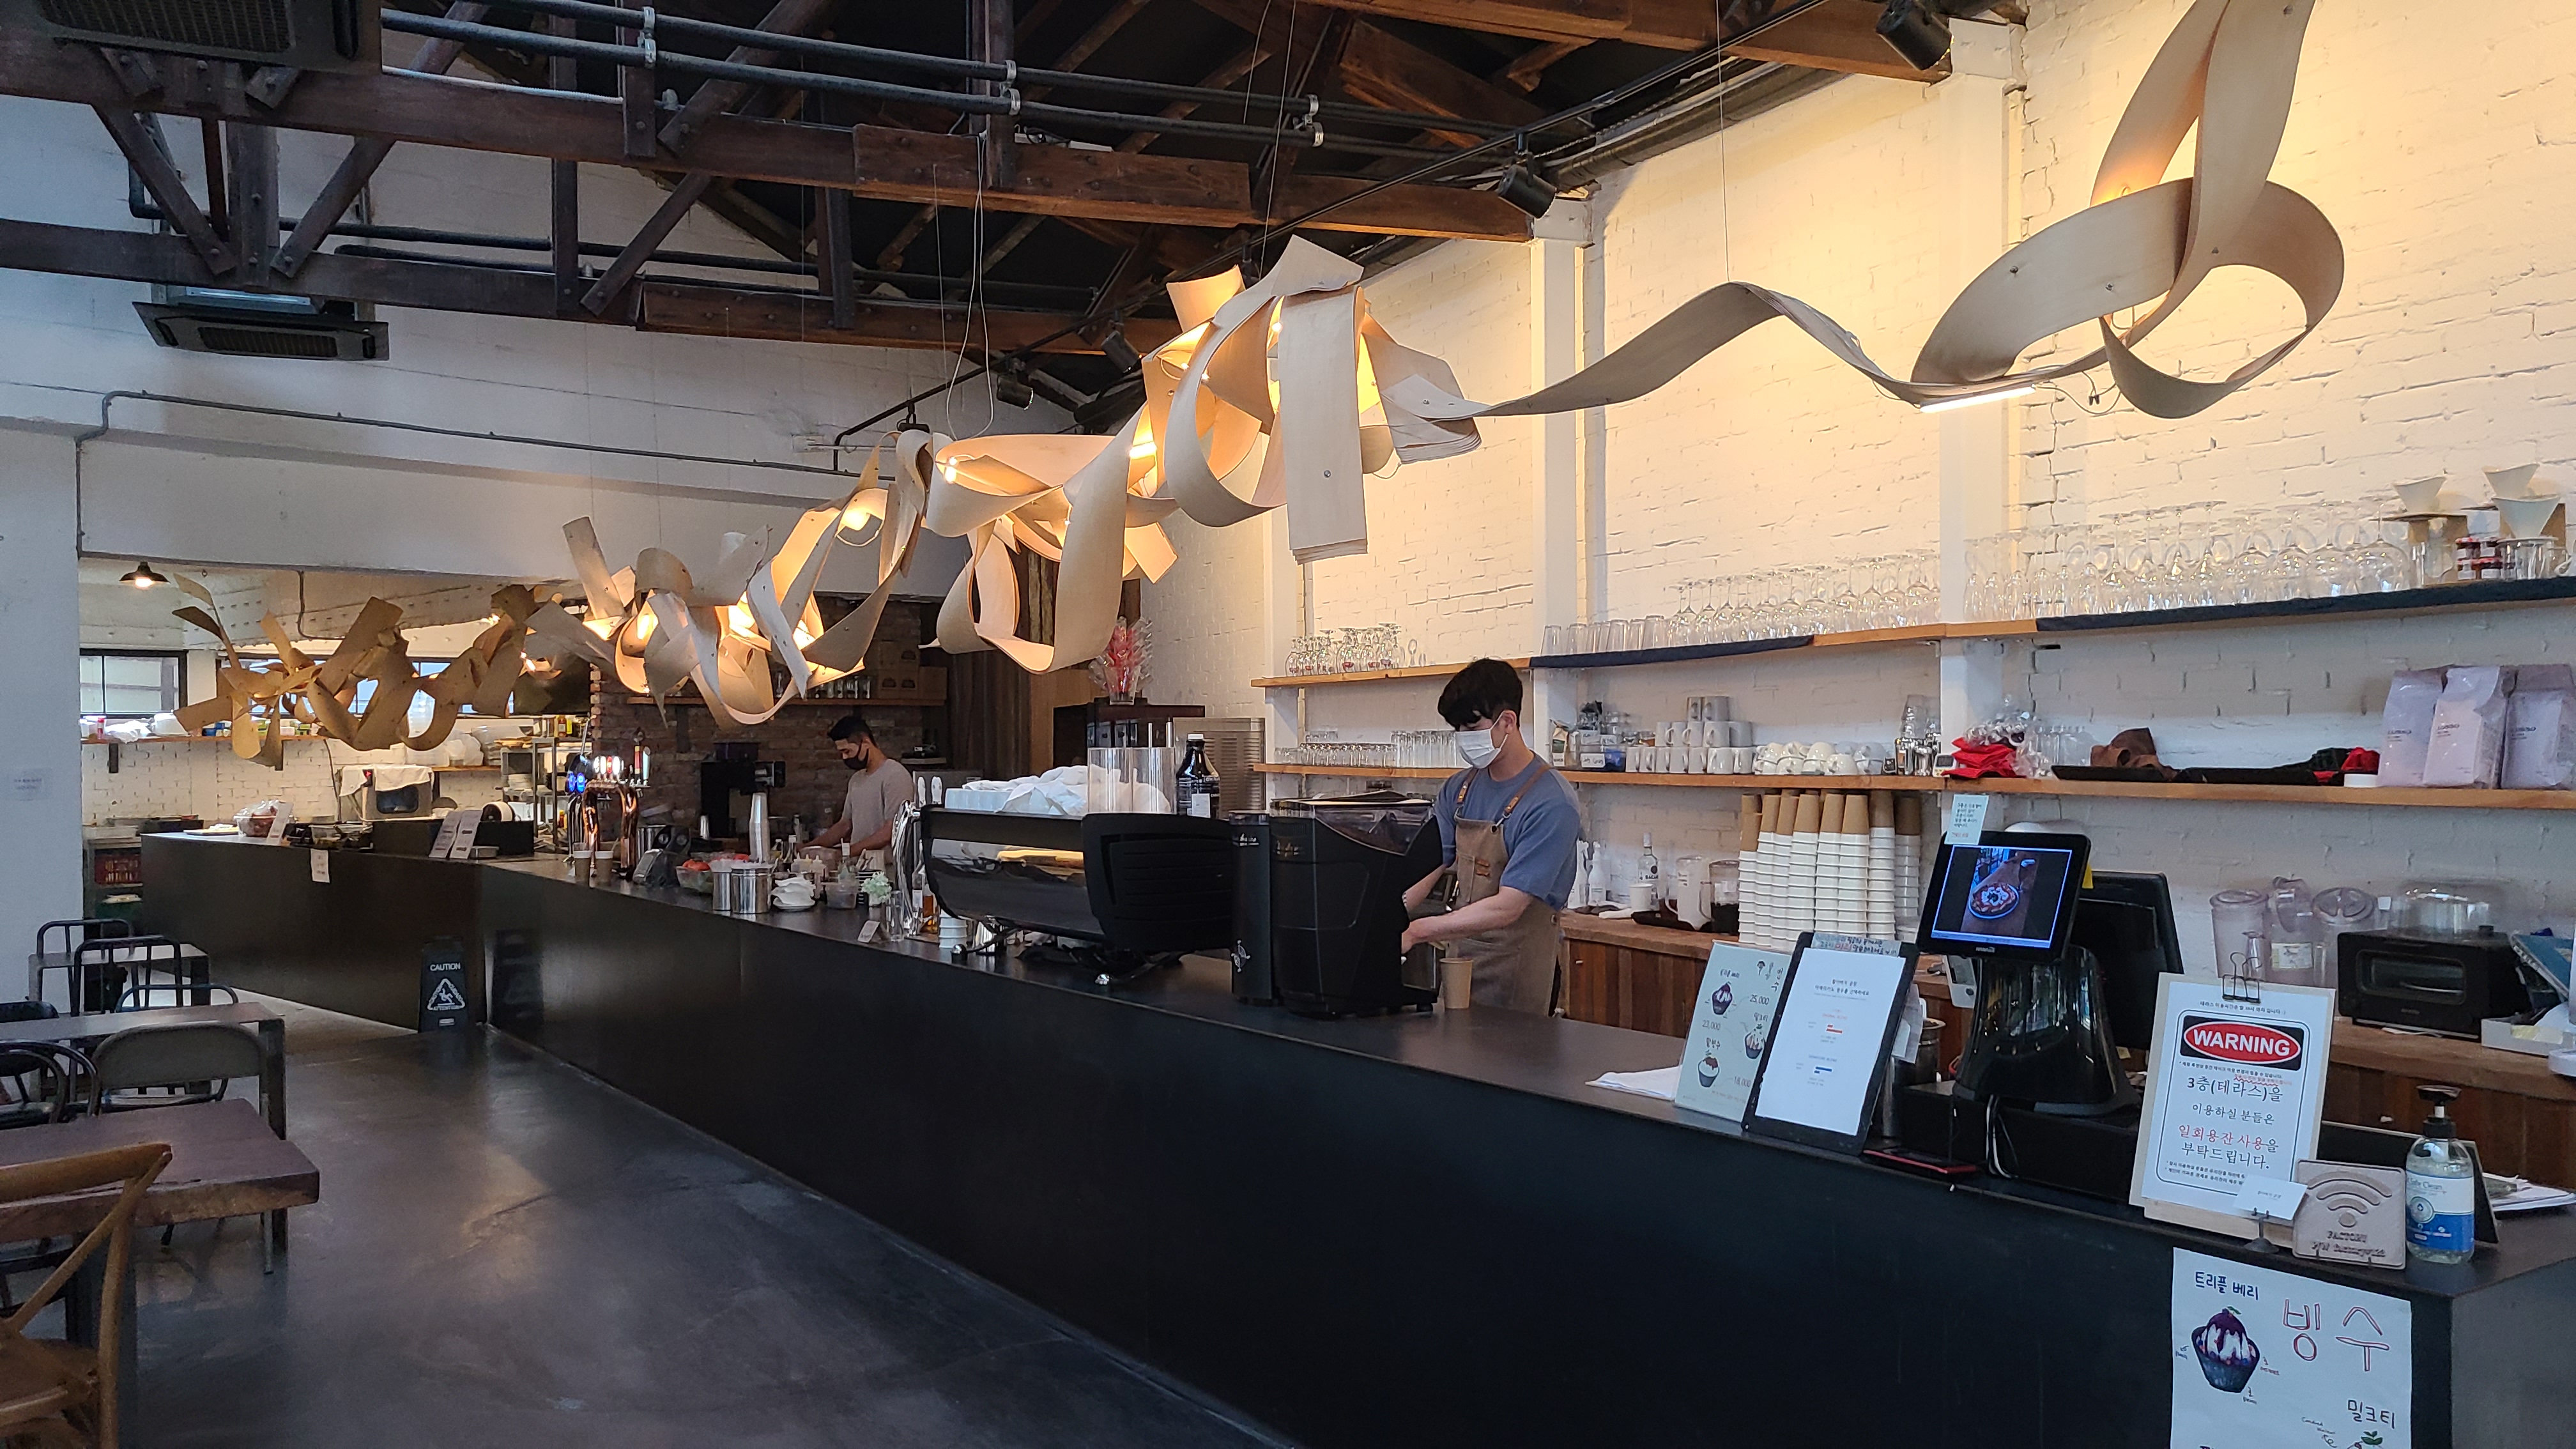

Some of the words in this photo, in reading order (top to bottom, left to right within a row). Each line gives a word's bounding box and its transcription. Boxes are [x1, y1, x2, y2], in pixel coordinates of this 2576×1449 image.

[430, 962, 461, 971] CAUTION
[1749, 994, 1770, 1006] 25,000
[1702, 1019, 1721, 1031] 23,000
[2193, 1029, 2290, 1056] WARNING
[2187, 1076, 2283, 1102] 3층(테라스)을
[2192, 1103, 2237, 1119] 이용하실
[2241, 1110, 2274, 1124] 분들은
[2179, 1124, 2234, 1146] 일회용잔
[2237, 1133, 2279, 1153] 사용을
[2181, 1142, 2269, 1169] 부탁드립니다.
[2195, 1271, 2227, 1294] 트리플
[2232, 1282, 2258, 1300] 베리
[2283, 1299, 2390, 1372] 빙수
[2347, 1399, 2395, 1429] 밀크티
